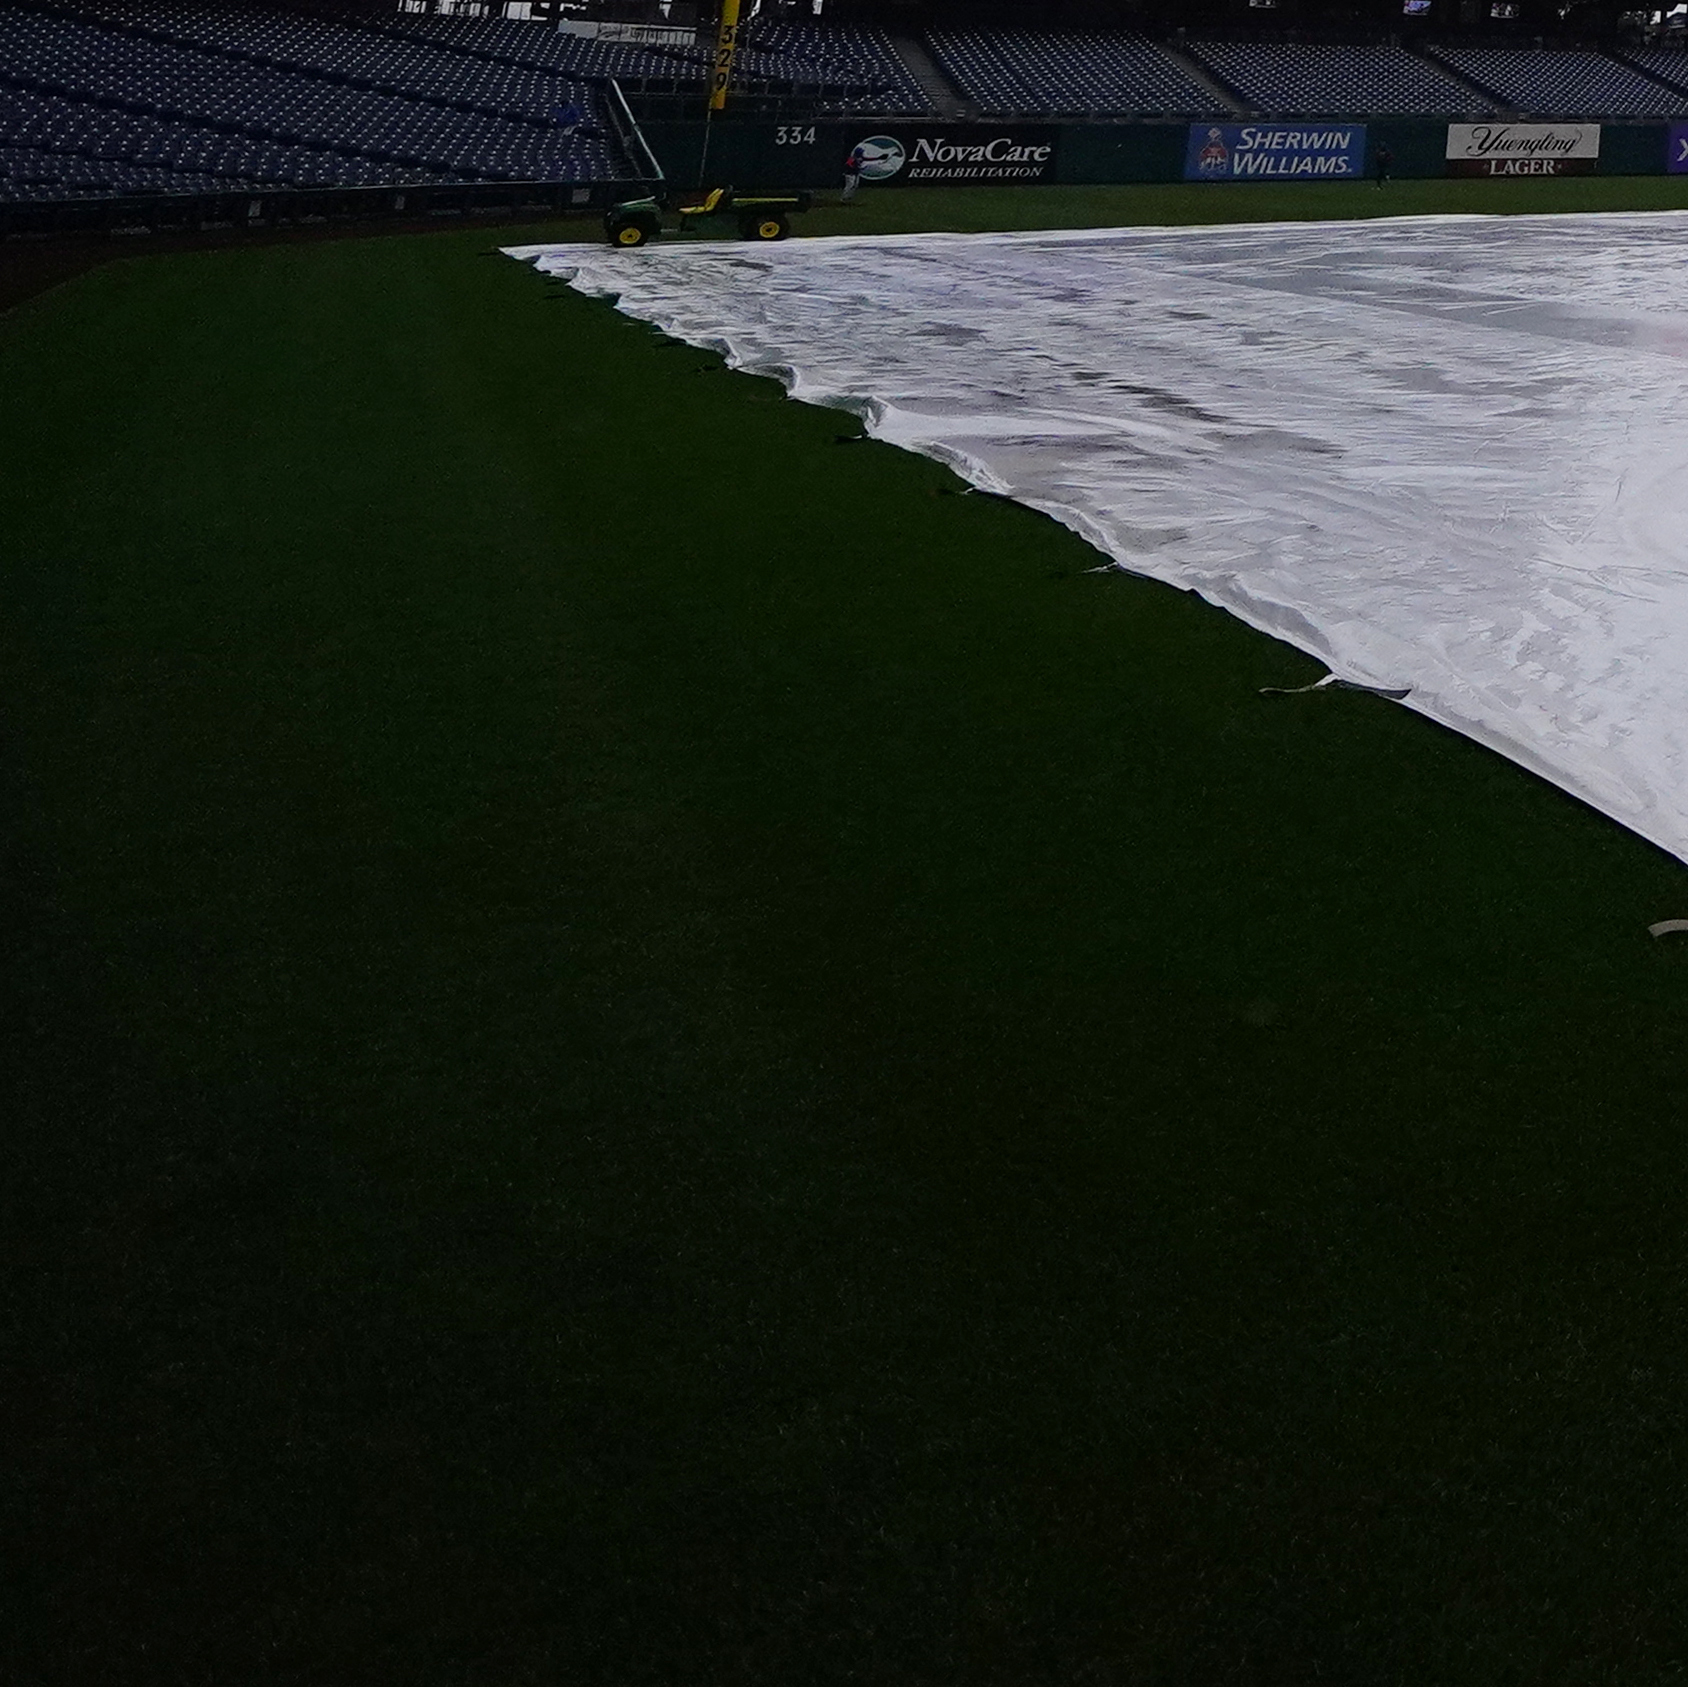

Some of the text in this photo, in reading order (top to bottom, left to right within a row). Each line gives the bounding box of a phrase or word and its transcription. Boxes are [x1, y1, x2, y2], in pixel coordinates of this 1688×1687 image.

[775, 126, 817, 145] 334
[1235, 128, 1351, 150] SHERWIN
[1465, 126, 1583, 158] Yuengling
[908, 138, 1051, 164] NovaCare
[907, 167, 1044, 179] REHABILITATION
[1233, 152, 1349, 175] WILLIAMS
[1489, 159, 1556, 175] LAGER
